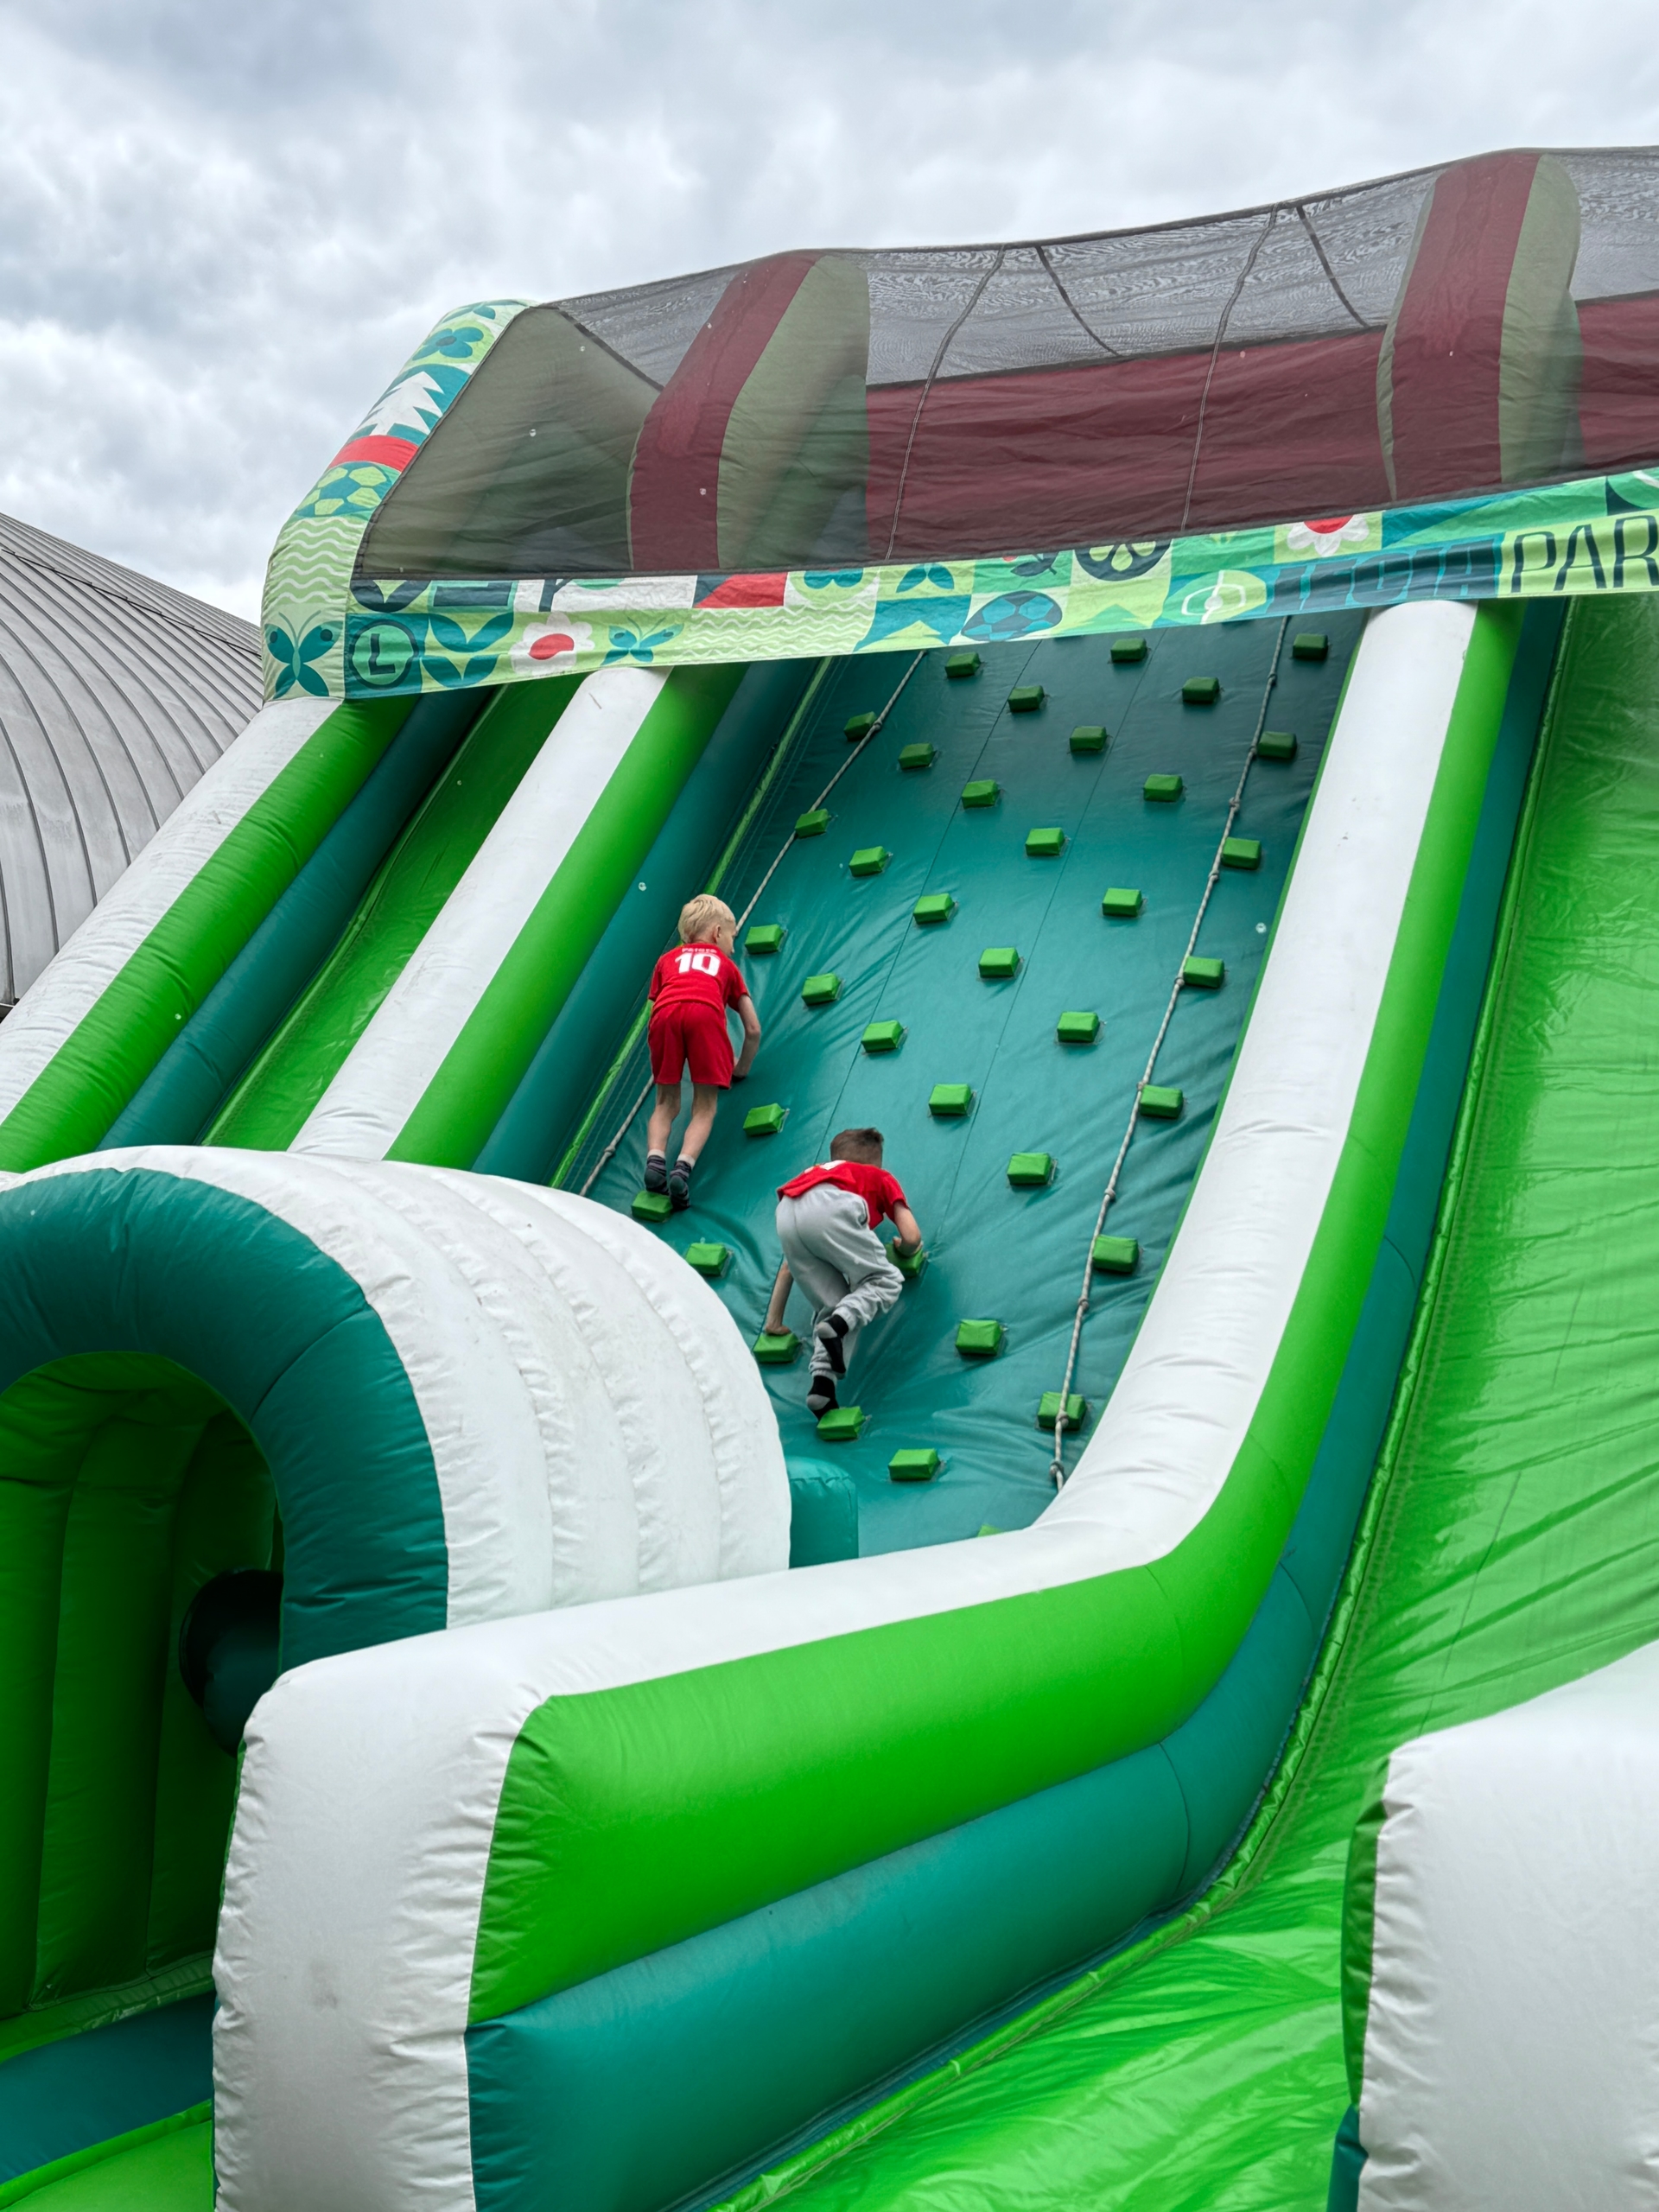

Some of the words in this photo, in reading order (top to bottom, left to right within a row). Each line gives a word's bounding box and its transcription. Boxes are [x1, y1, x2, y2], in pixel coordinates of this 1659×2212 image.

[1510, 515, 1659, 594] PAR
[368, 633, 396, 676] L
[675, 952, 721, 976] 10
